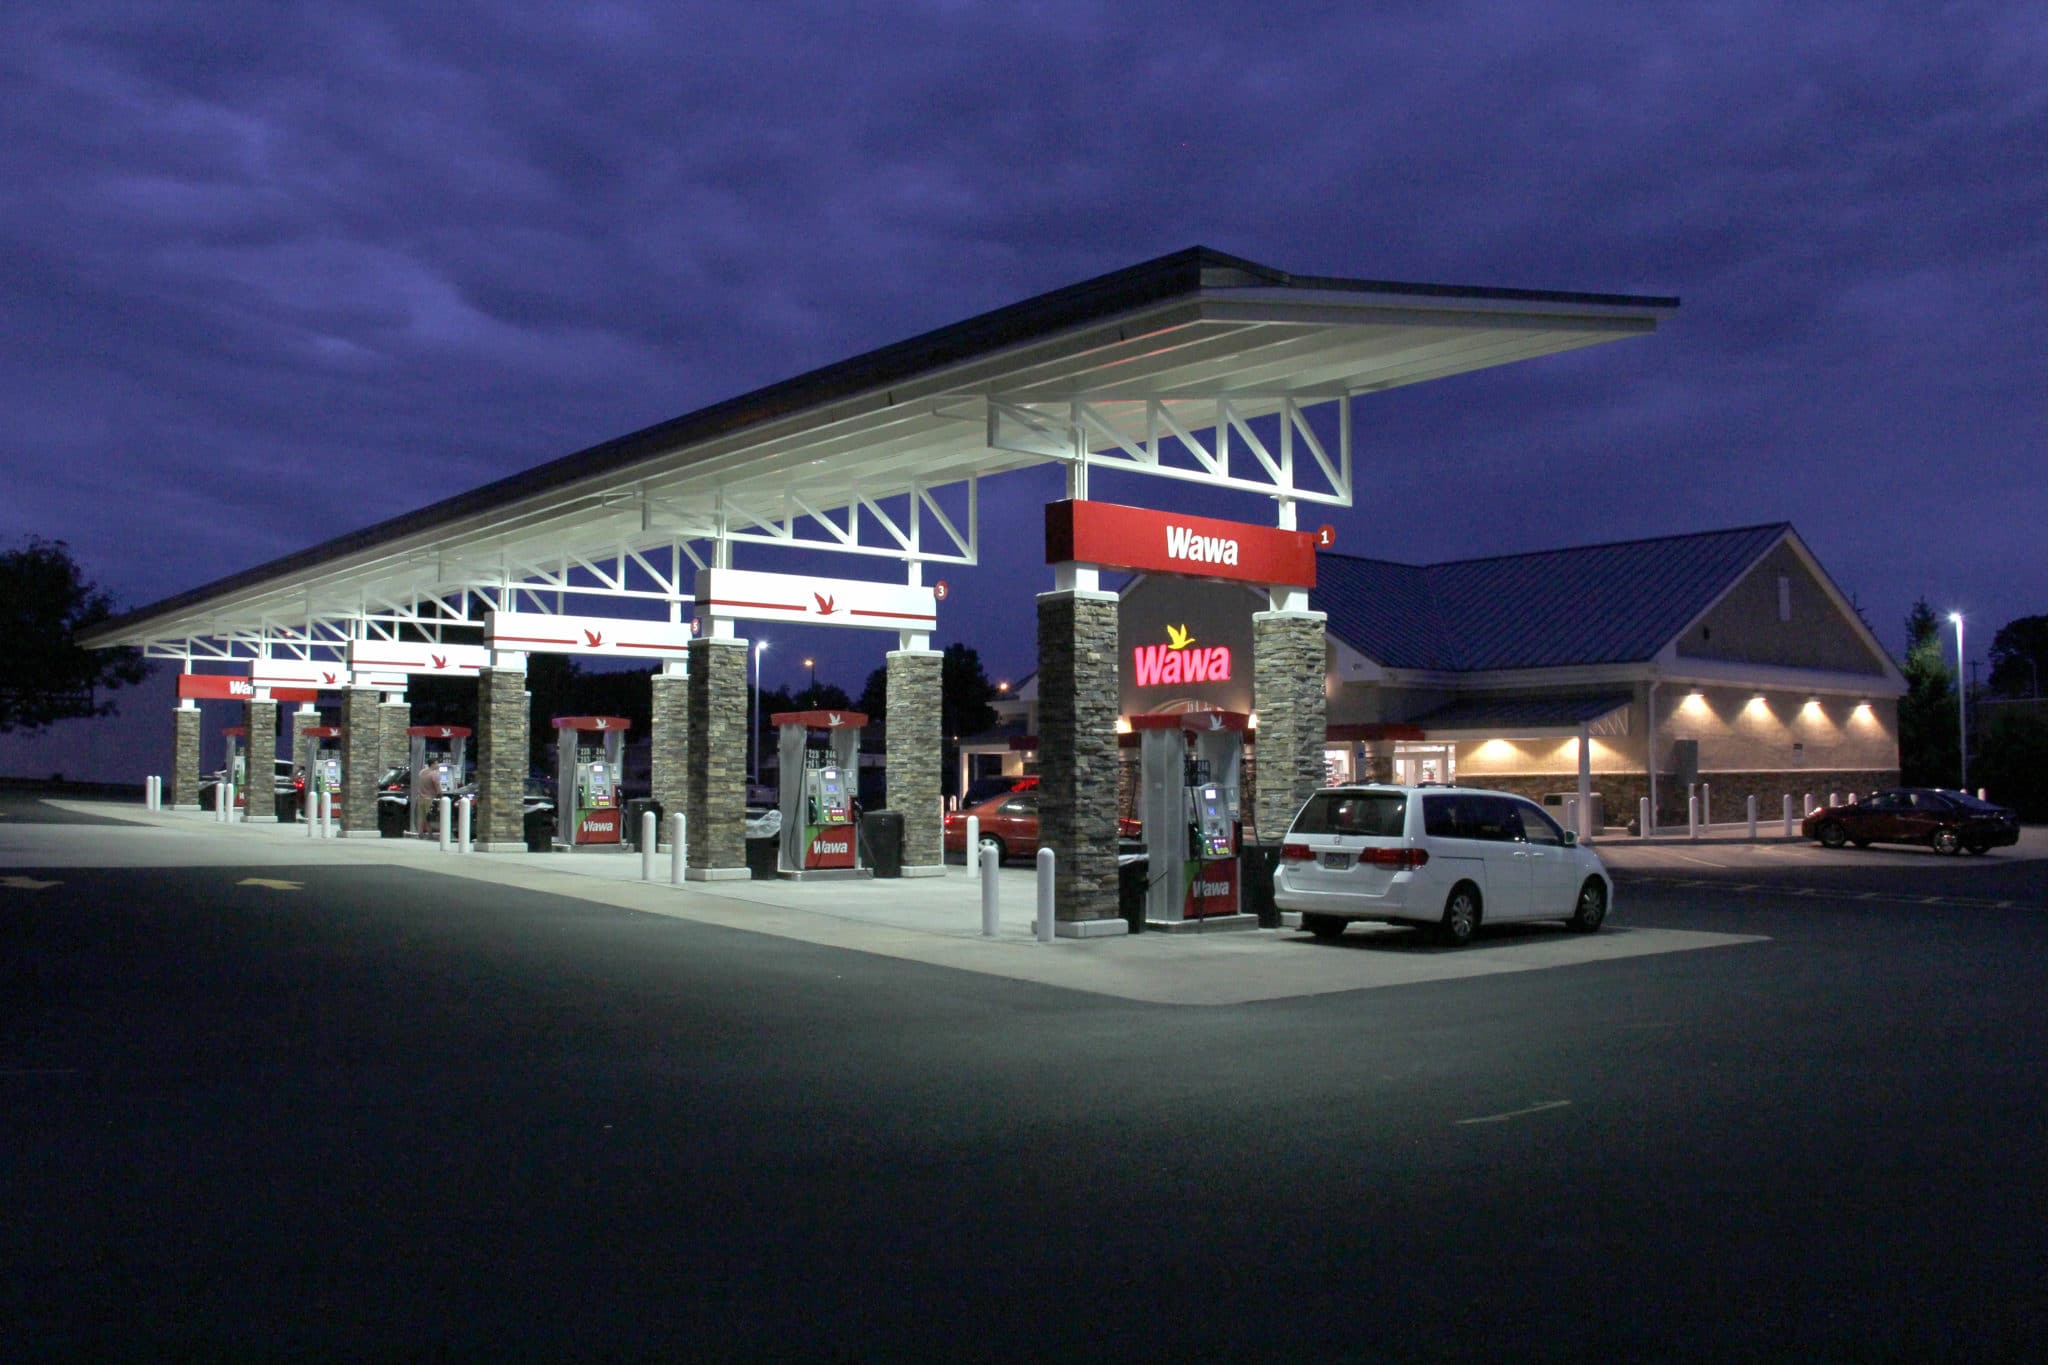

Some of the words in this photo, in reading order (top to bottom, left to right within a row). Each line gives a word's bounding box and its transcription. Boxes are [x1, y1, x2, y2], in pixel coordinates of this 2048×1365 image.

[1321, 530, 1330, 544] 1
[1166, 525, 1239, 566] Wawa
[938, 585, 945, 597] 3
[1134, 643, 1231, 687] Wawa
[583, 820, 614, 832] Wawa
[813, 840, 848, 854] Wawa
[1192, 880, 1230, 898] Wawa
